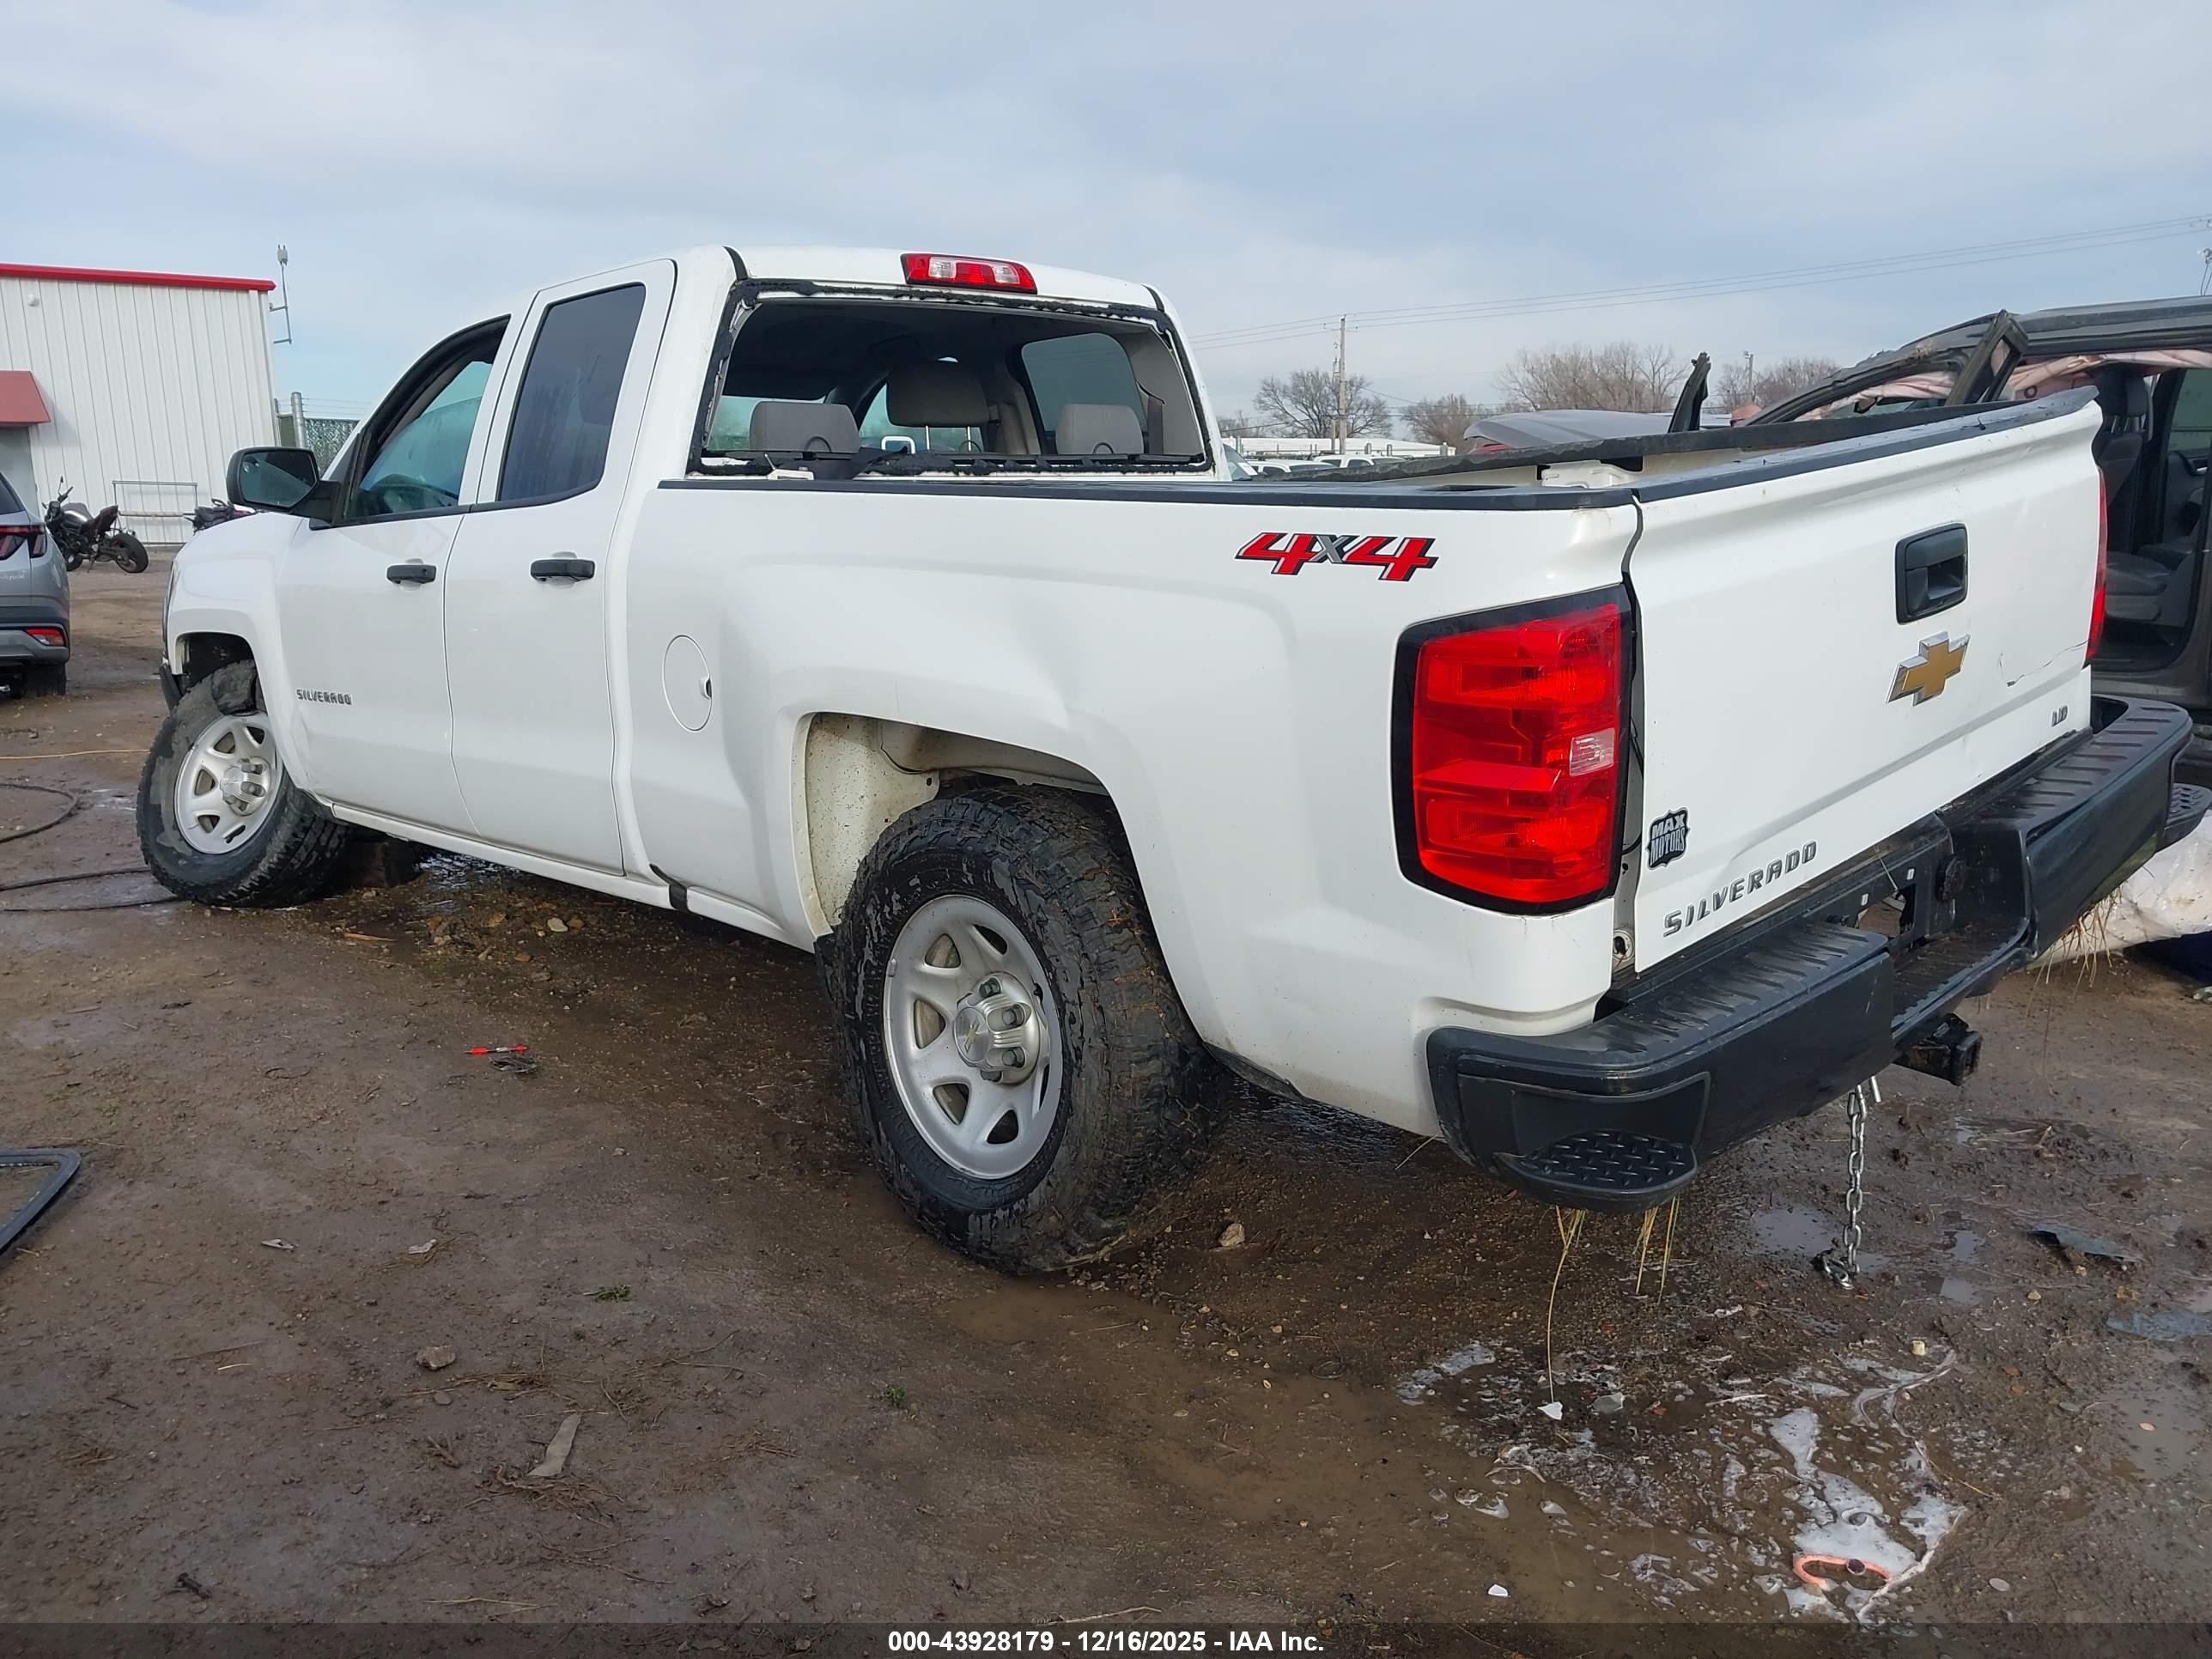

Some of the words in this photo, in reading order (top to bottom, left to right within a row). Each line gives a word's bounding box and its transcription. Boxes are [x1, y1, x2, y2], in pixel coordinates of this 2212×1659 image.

[295, 689, 352, 705] SILVERADO
[2051, 705, 2069, 727] LD
[1651, 812, 1686, 840] MAX
[1650, 827, 1686, 866] MOTORS
[1662, 840, 1818, 938] SILVERADO
